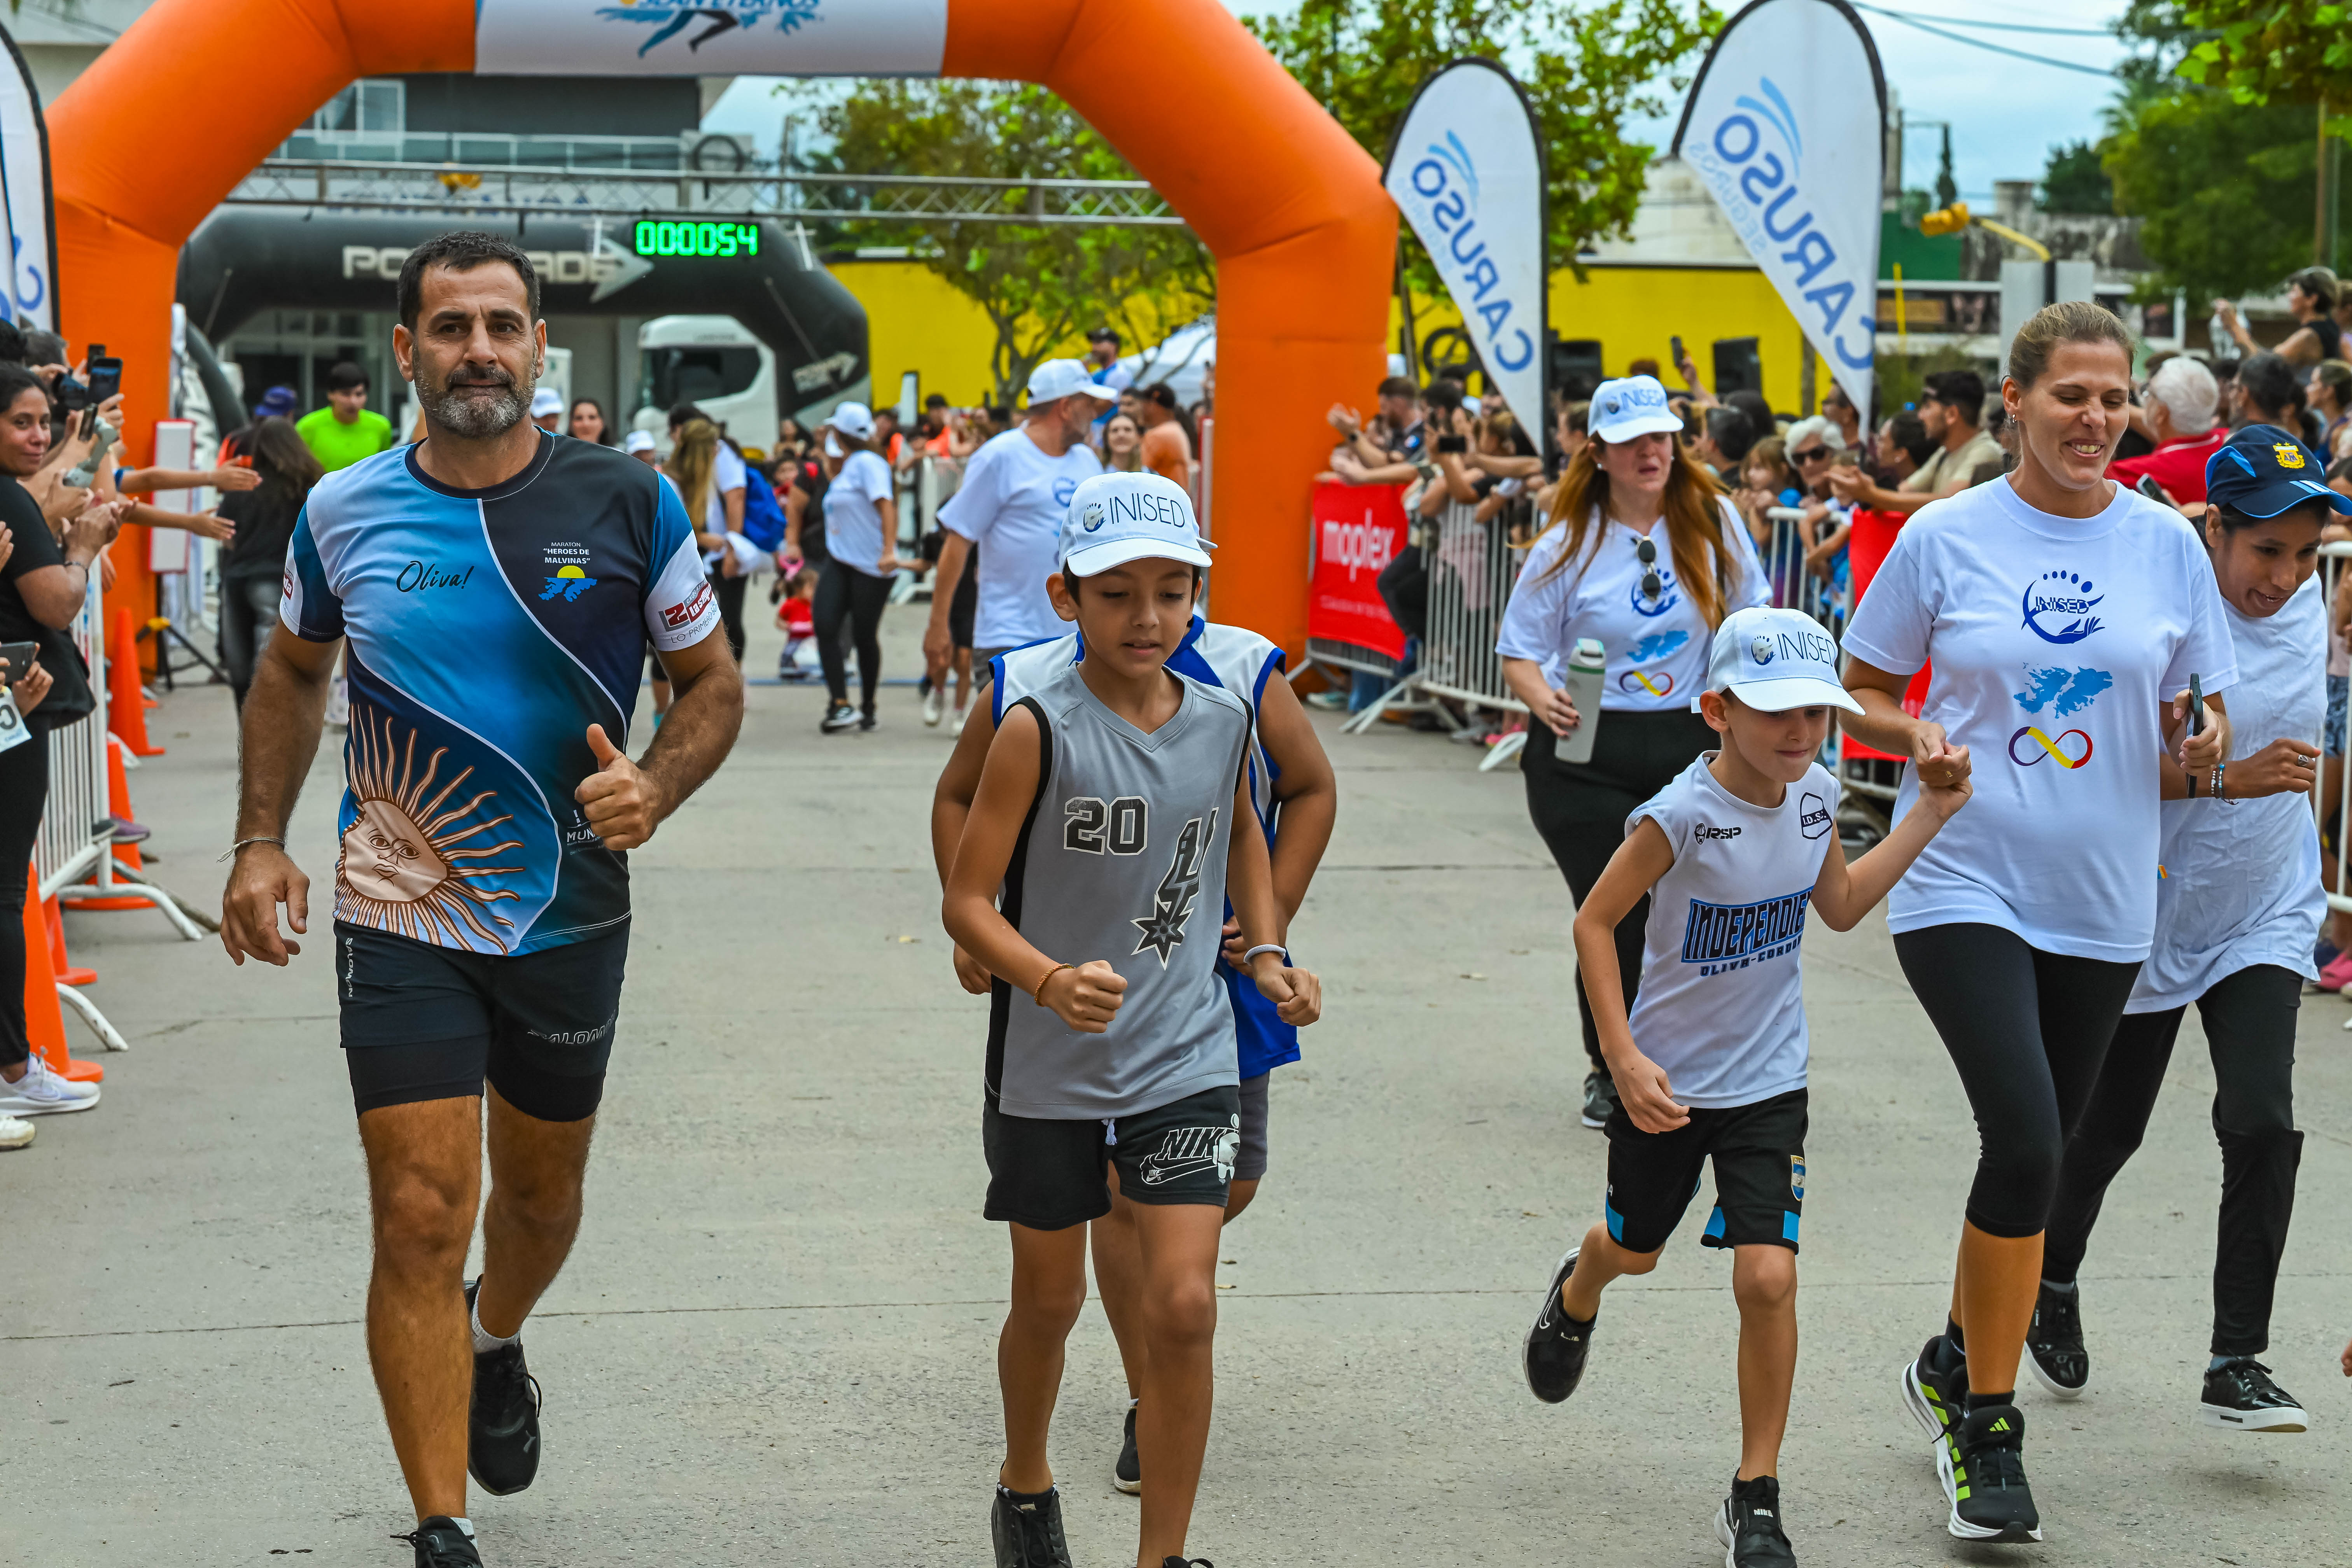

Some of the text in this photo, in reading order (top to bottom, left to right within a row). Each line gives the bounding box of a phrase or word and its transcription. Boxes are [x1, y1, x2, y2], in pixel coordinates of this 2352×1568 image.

[342, 246, 619, 284] POADE
[1110, 493, 1185, 527] INISED
[396, 560, 474, 593] Oliva!
[2035, 596, 2090, 614] INISED
[670, 634, 686, 643] LO
[688, 612, 712, 637] PRIMERO
[1777, 631, 1836, 667] INISED
[1064, 795, 1148, 856] 20
[1705, 826, 1742, 840] RSP
[1684, 889, 1811, 959] INDEPENDIE
